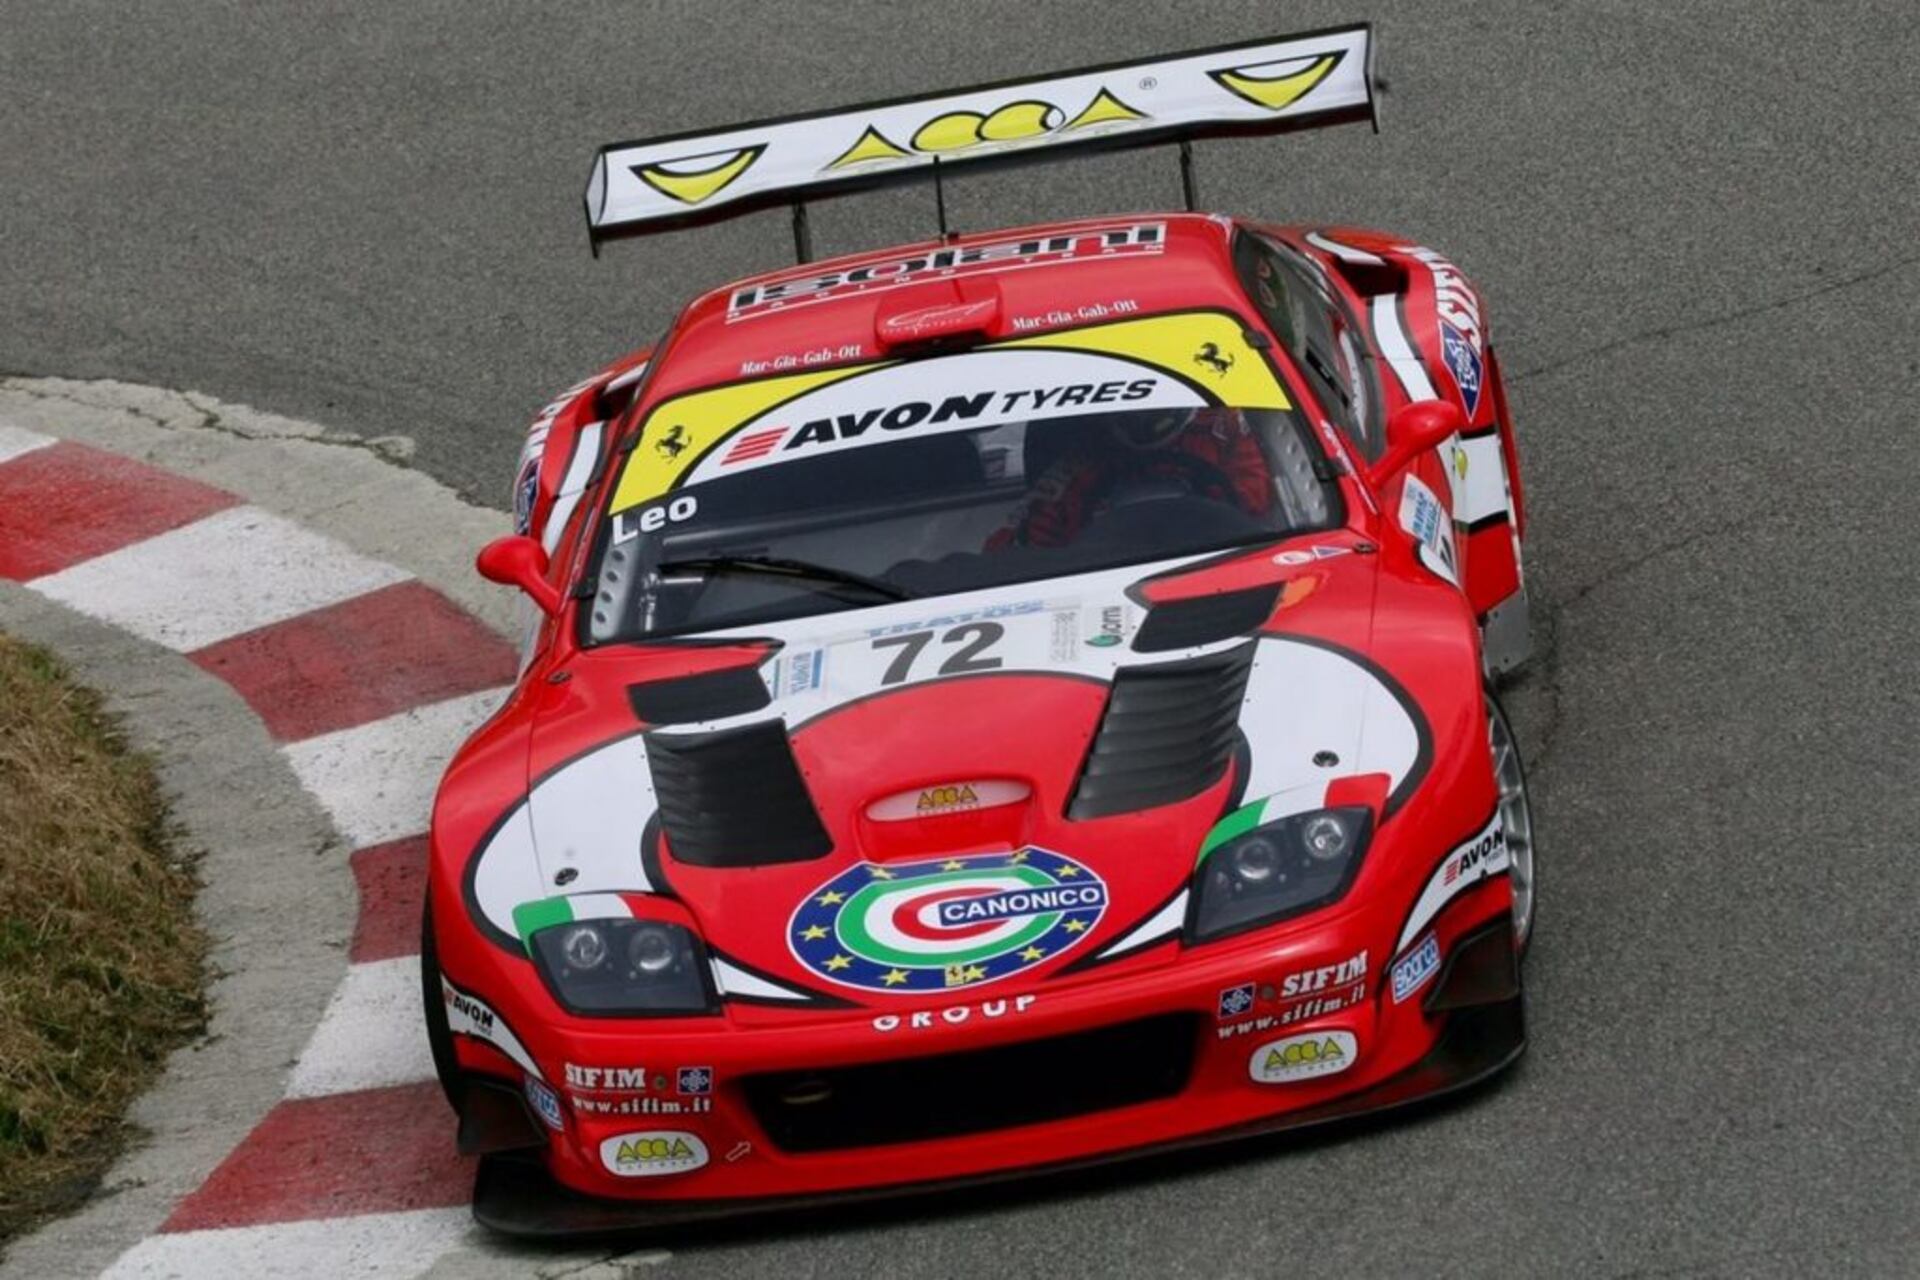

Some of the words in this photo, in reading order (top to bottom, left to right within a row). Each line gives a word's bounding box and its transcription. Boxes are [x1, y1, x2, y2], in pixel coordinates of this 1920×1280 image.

[785, 391, 996, 450] AVON
[1002, 378, 1158, 414] TYRES
[612, 496, 698, 545] Leo
[871, 621, 1006, 686] 72
[1458, 829, 1503, 876] AVON
[944, 886, 1100, 922] CANONICO
[1280, 950, 1368, 998] SIFIM
[453, 995, 494, 1028] AVON
[872, 994, 1037, 1032] GROUP
[1217, 984, 1365, 1039] www.sifim.it
[564, 1062, 646, 1089] SIFIM
[571, 1095, 711, 1114] www.sifim.it
